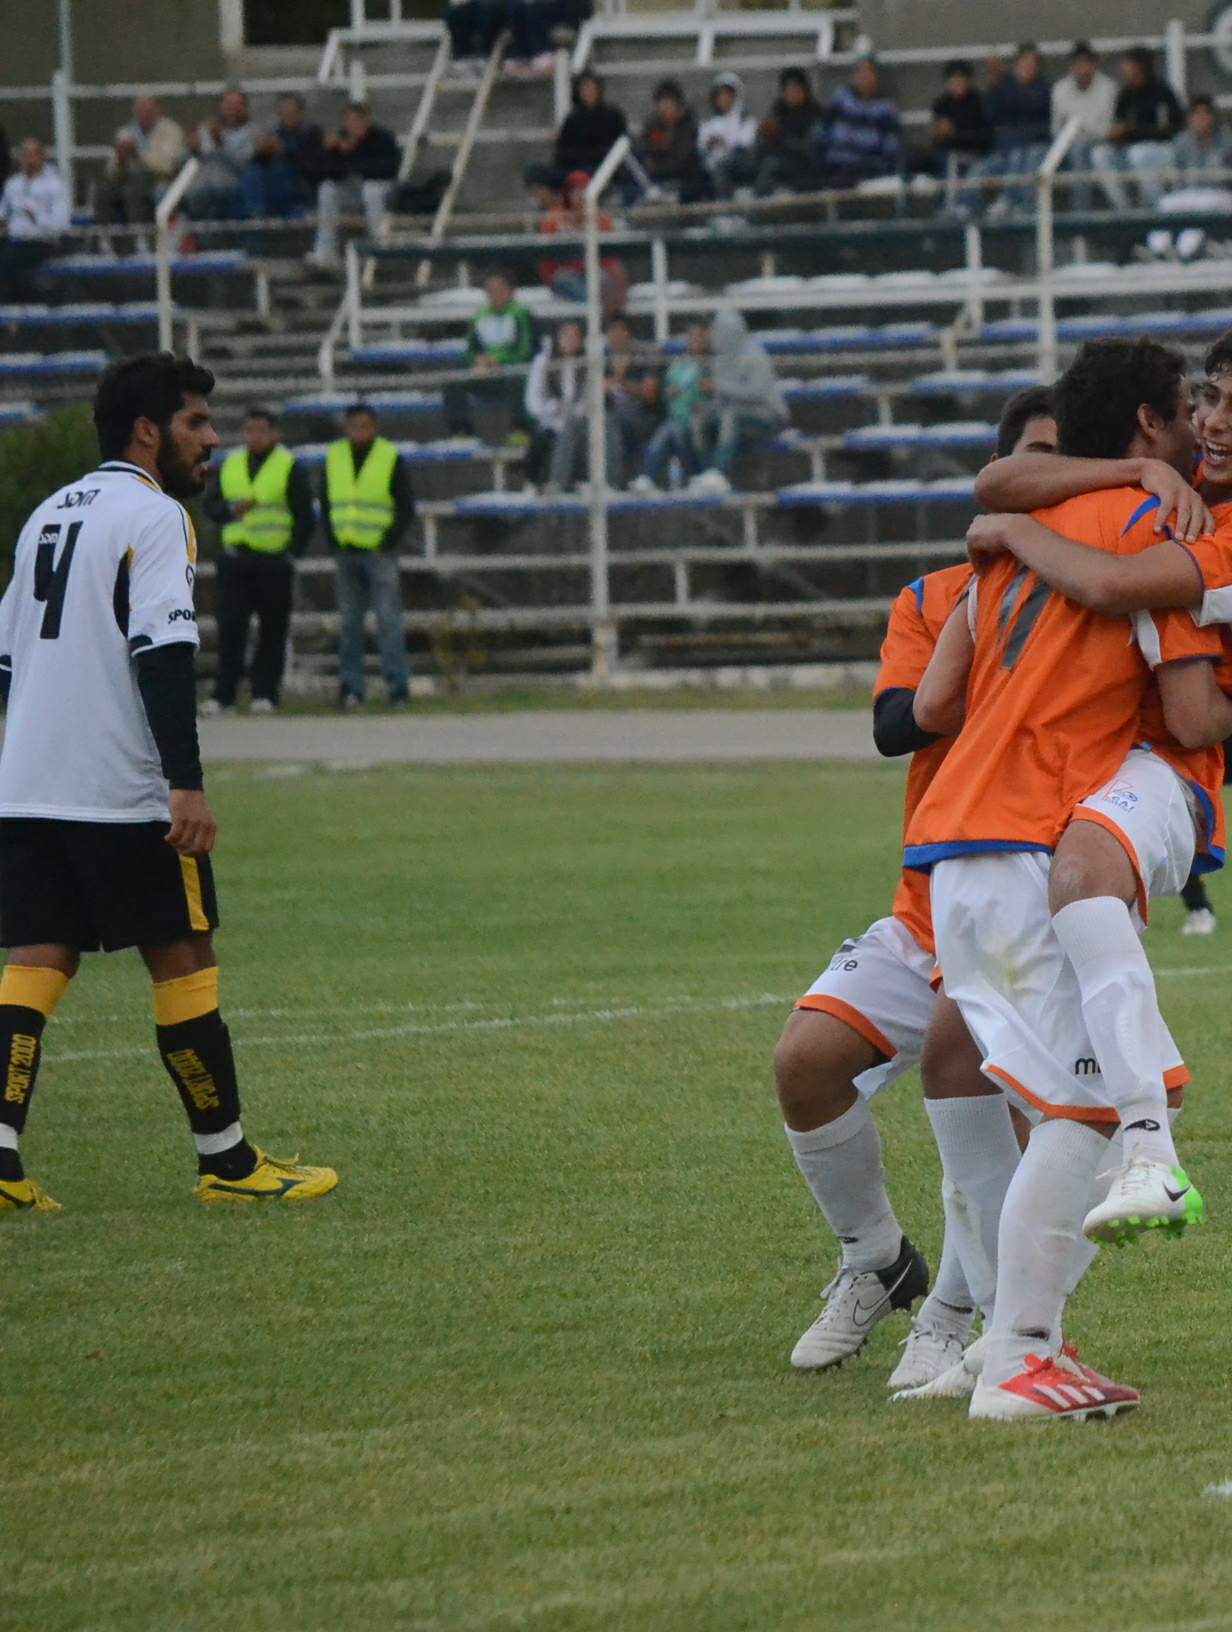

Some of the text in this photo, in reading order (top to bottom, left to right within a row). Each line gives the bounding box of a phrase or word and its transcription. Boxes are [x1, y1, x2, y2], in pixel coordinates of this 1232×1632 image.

[33, 520, 84, 640] 4
[4, 1033, 37, 1105] SPORT 2000
